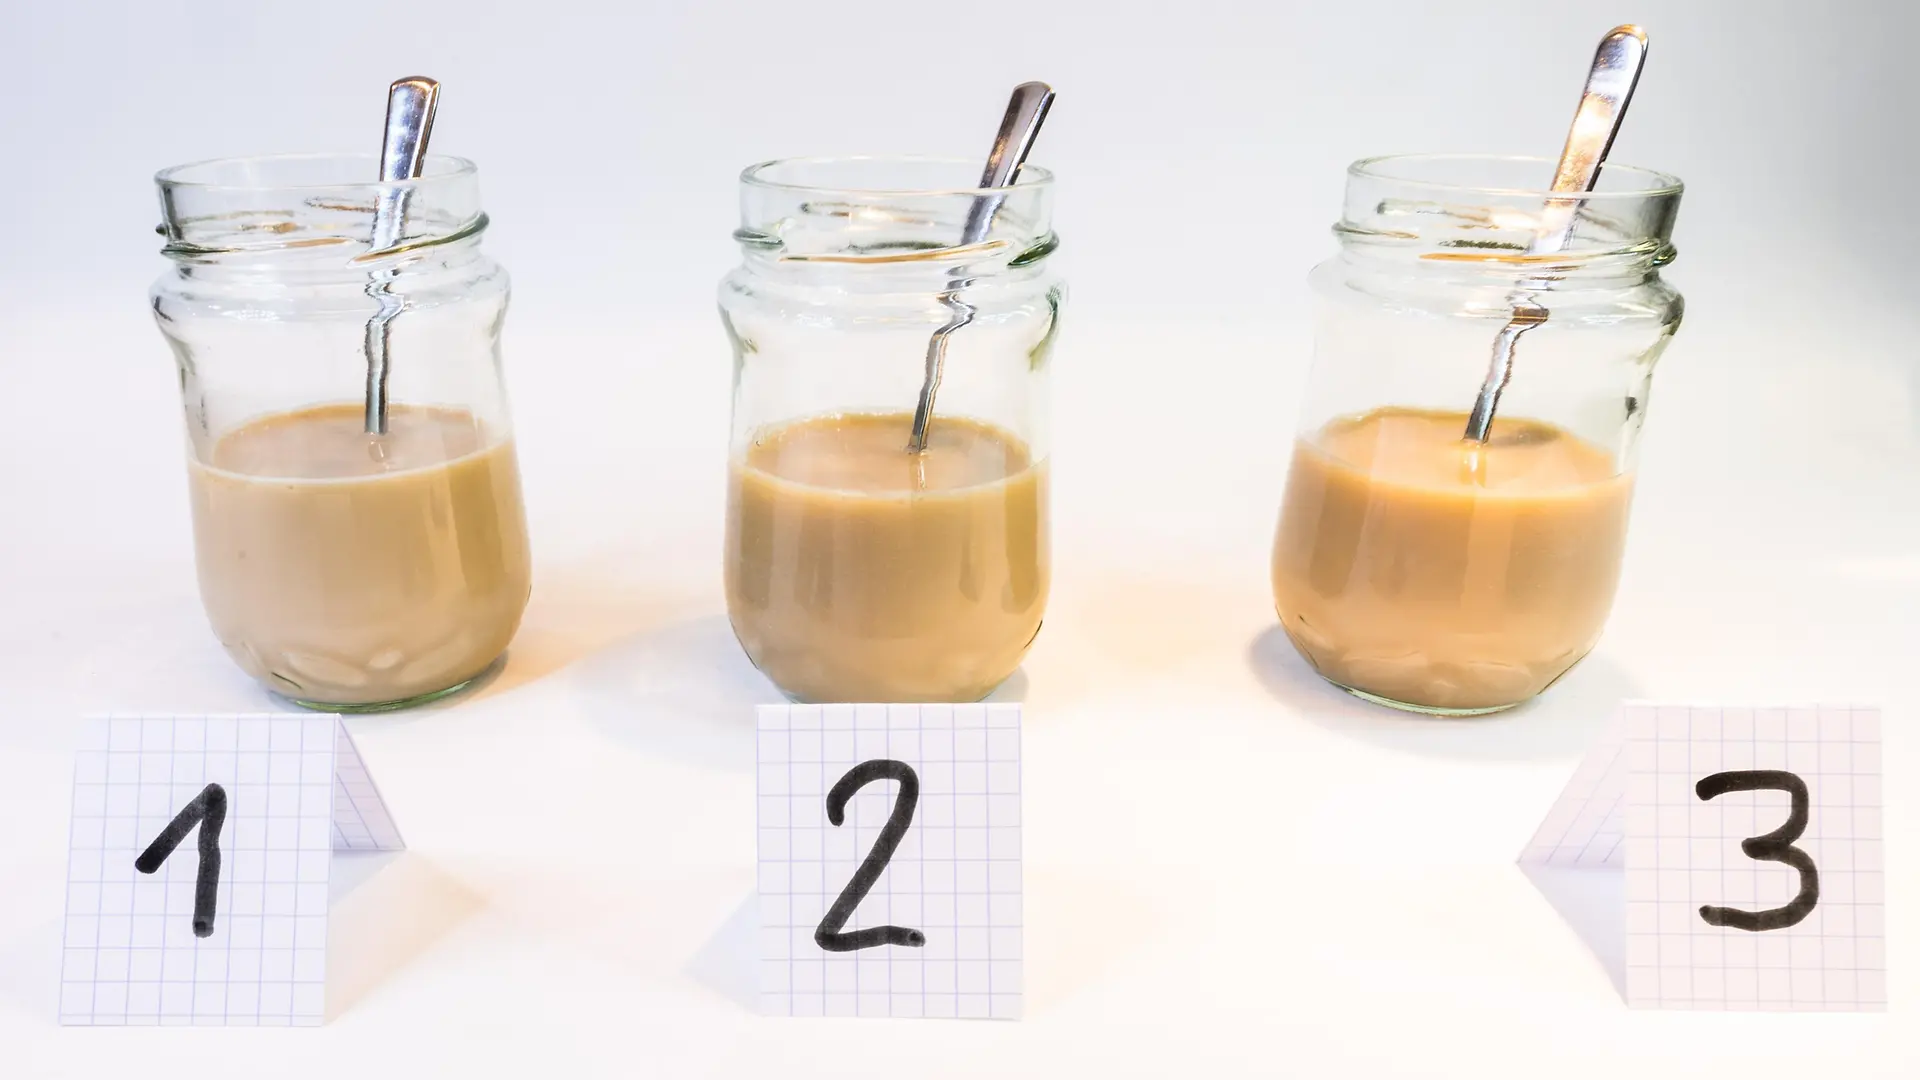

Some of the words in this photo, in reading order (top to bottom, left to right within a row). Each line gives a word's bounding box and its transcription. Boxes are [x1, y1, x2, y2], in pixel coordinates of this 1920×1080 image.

[135, 783, 227, 938] 1
[815, 759, 925, 952] 2
[1695, 770, 1819, 932] 3
